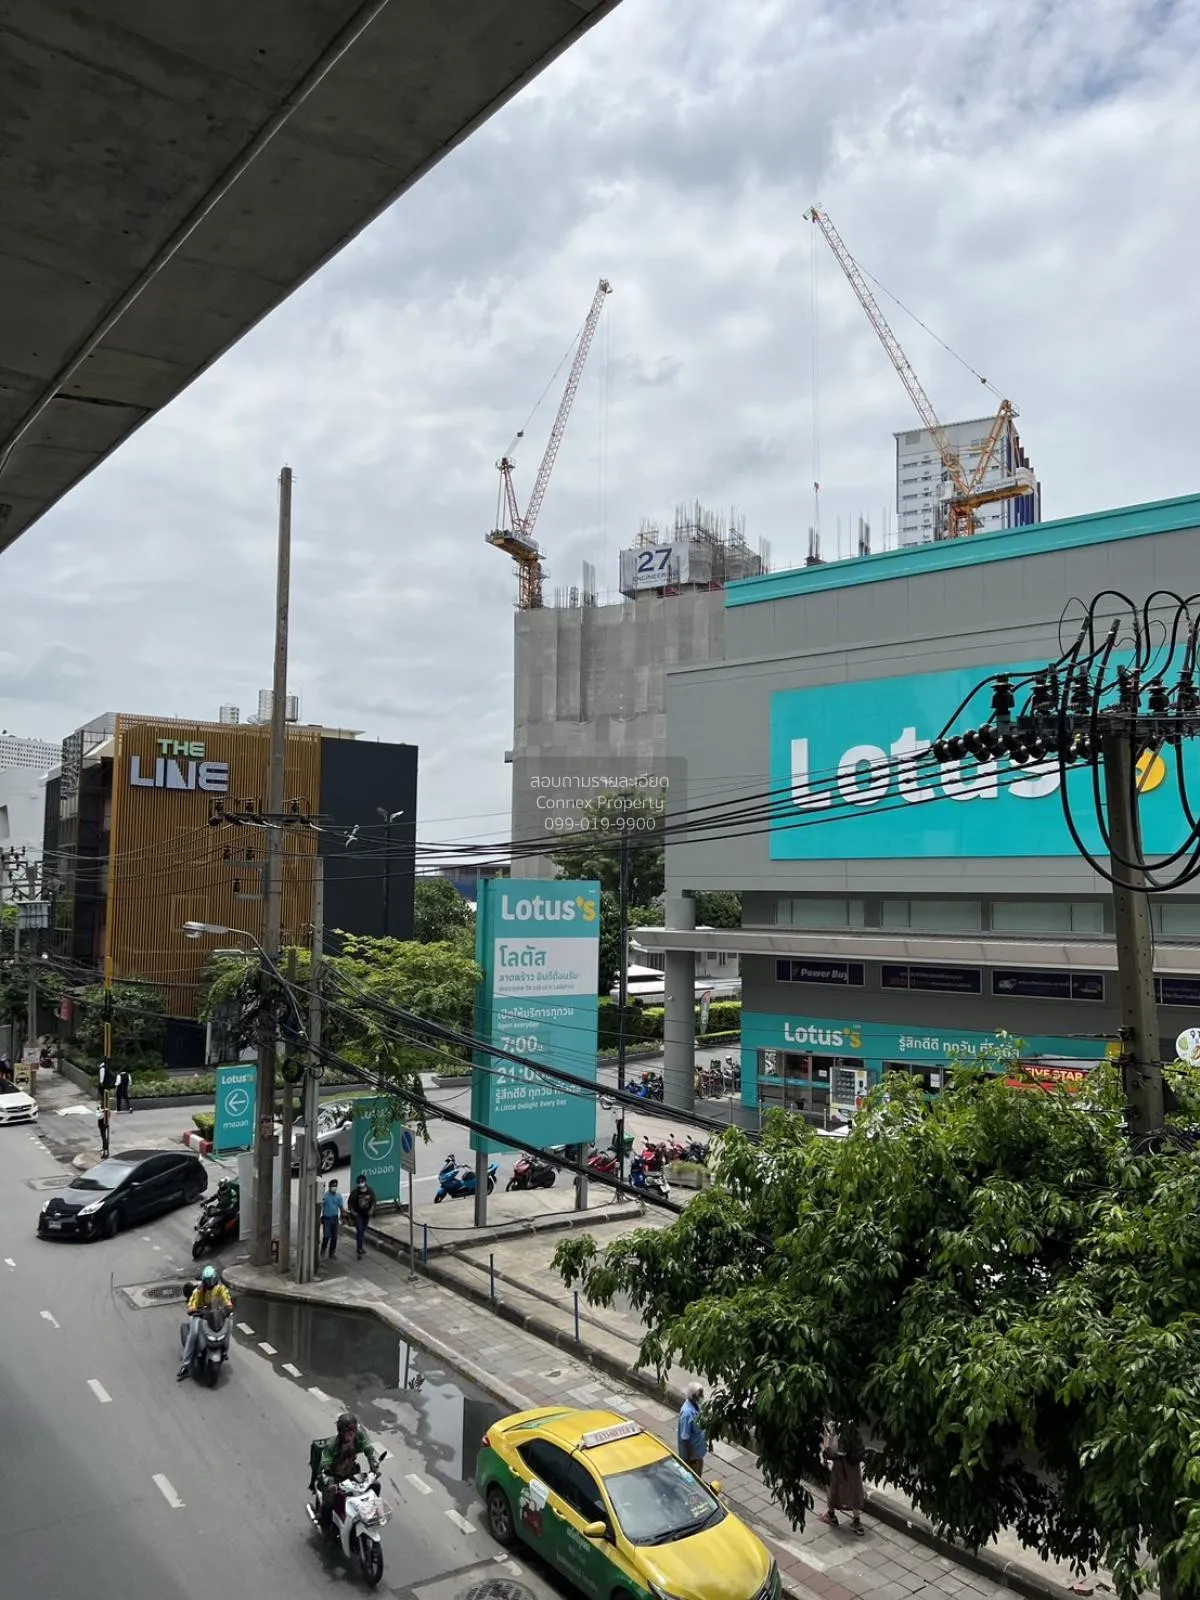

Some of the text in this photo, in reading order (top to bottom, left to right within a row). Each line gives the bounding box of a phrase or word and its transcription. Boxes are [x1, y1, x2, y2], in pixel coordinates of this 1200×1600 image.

[637, 548, 672, 573] 27
[156, 738, 205, 758] THE
[130, 755, 229, 791] LINE
[501, 894, 597, 922] Lotus's
[499, 944, 547, 967] โลตัส
[801, 968, 830, 978] Power
[783, 1022, 862, 1049] Lotus's
[1052, 1070, 1084, 1081] STAR
